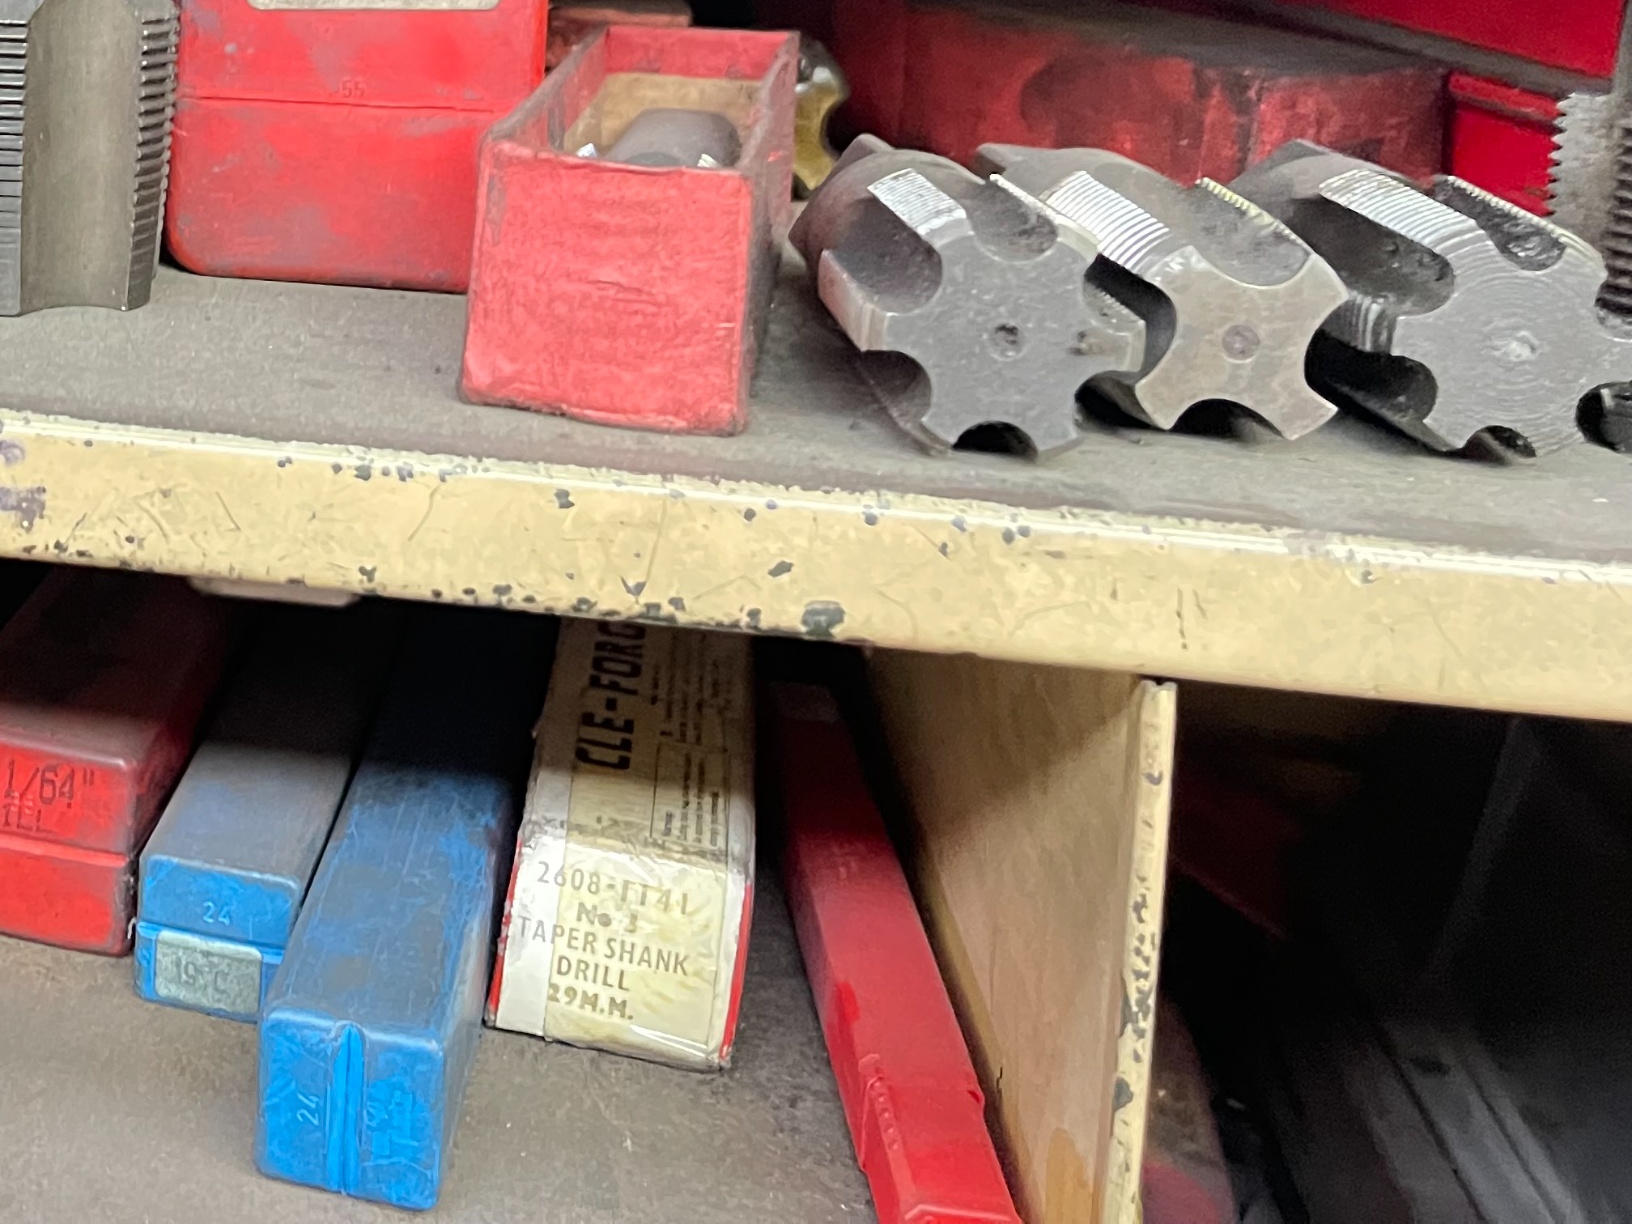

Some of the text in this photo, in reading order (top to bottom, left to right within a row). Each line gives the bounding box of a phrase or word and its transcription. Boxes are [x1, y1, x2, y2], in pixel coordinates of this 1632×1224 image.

[202, 901, 230, 926] 24
[518, 916, 690, 977] TAPER SHANK
[557, 954, 630, 992] DRILL
[296, 1093, 320, 1126] 24
